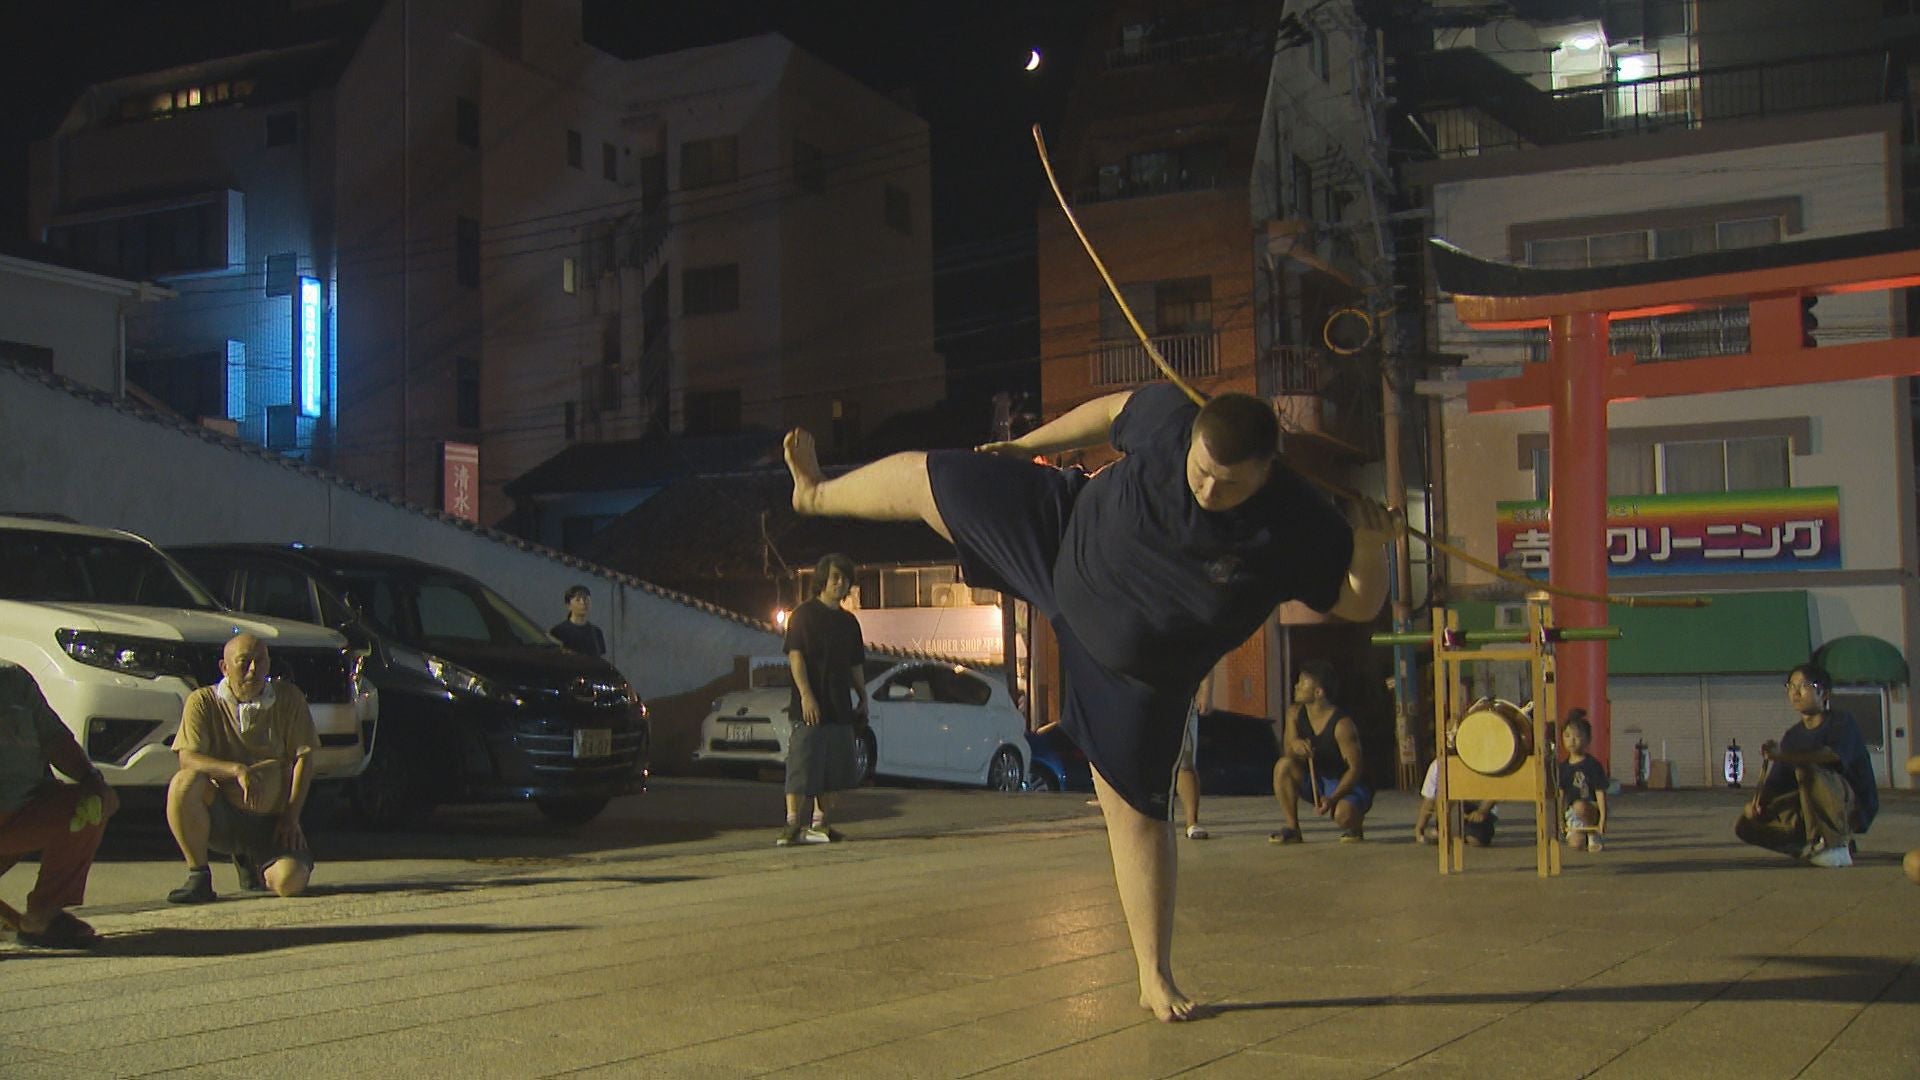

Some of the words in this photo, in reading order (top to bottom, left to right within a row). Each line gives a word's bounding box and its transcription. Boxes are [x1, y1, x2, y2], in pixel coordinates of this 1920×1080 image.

[1512, 519, 1824, 570] 吉クリーニング
